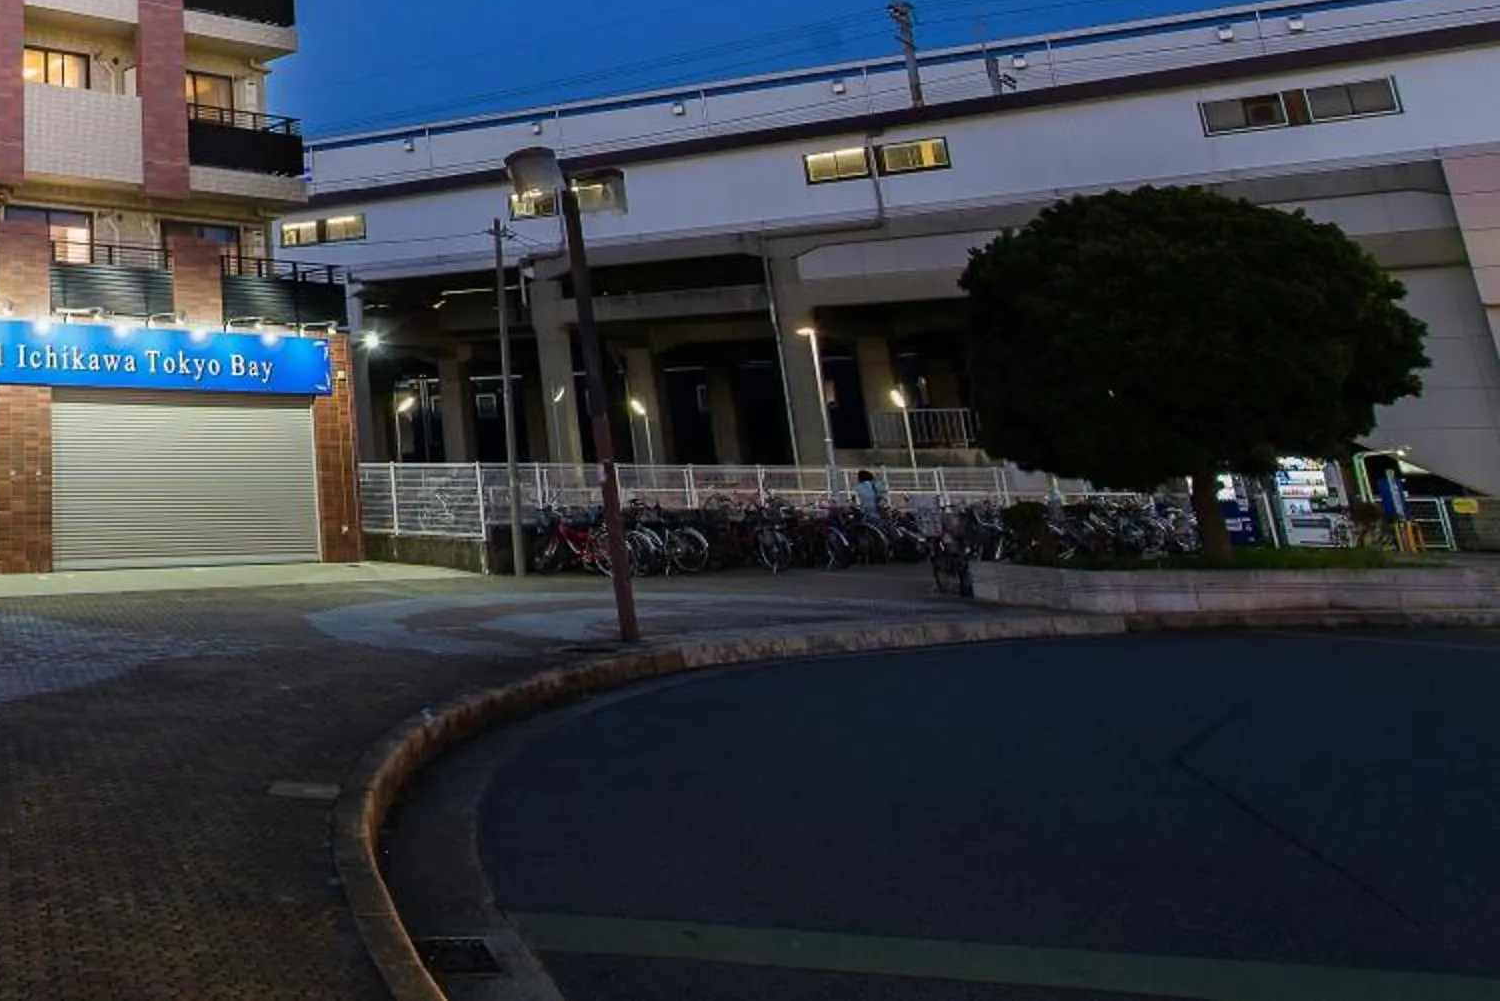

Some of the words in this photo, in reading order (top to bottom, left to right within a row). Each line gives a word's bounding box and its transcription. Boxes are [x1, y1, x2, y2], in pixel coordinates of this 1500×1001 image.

[16, 344, 137, 373] Ichikawa
[147, 350, 221, 380] Tokyo
[230, 354, 274, 383] Bay
